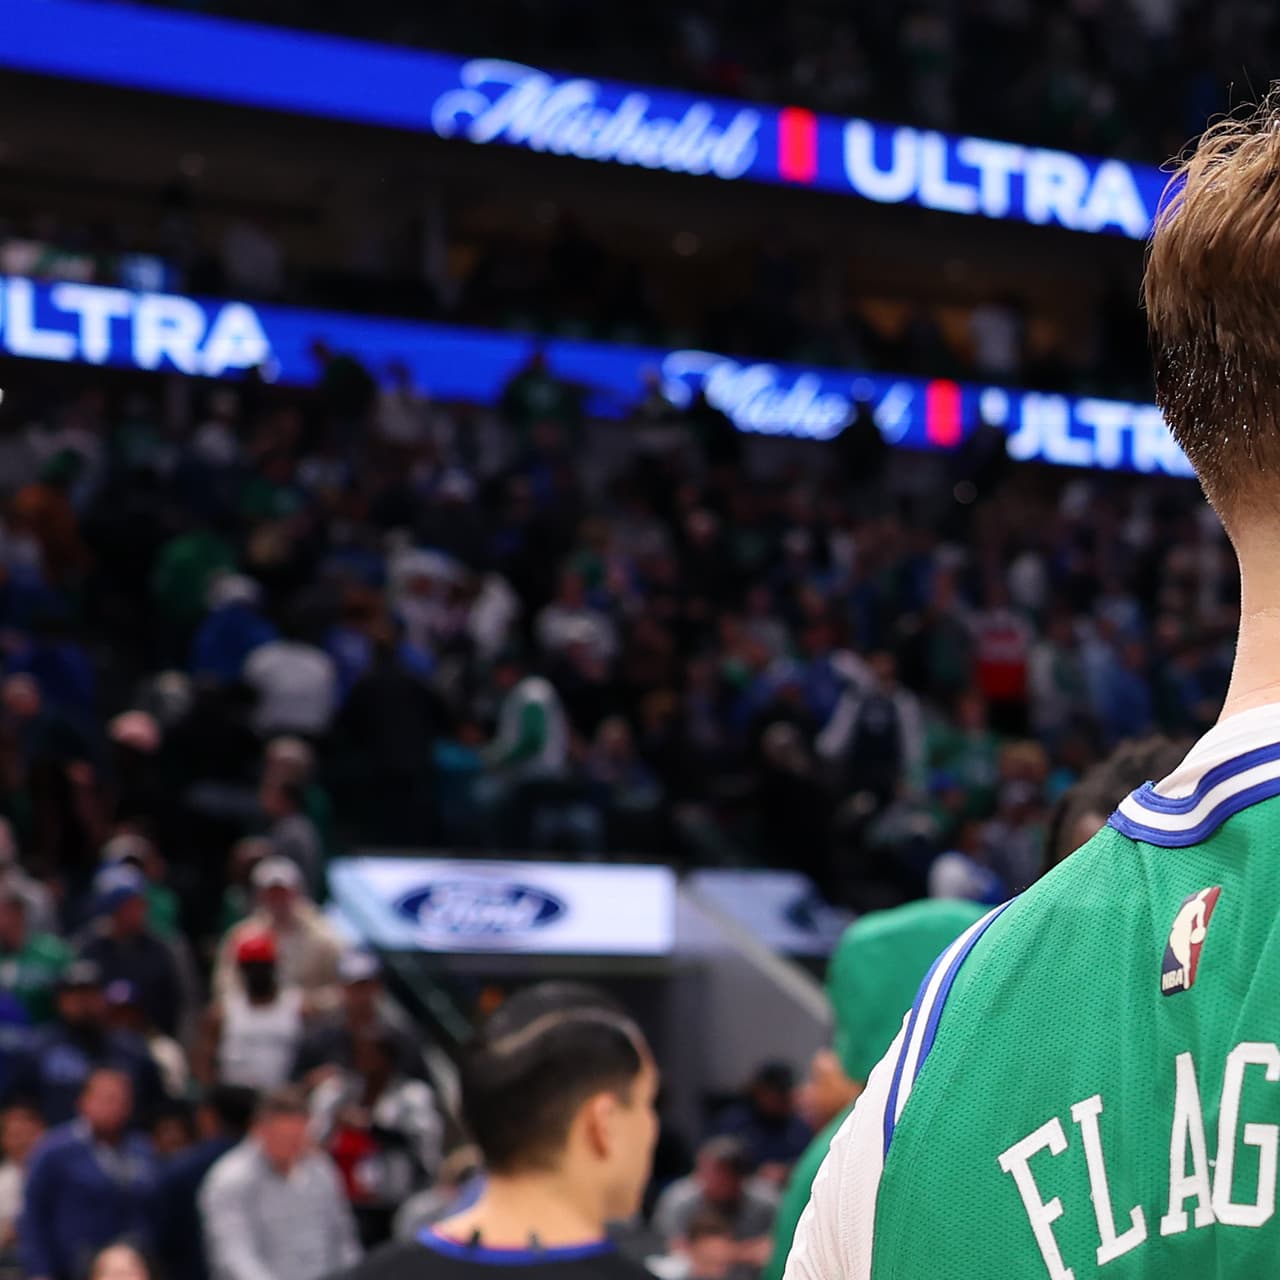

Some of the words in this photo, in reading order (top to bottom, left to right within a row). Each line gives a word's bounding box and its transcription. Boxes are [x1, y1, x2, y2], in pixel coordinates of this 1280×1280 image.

[843, 118, 1150, 240] ULTRA
[0, 277, 272, 378] LTRA
[980, 387, 1200, 478] ULTR
[1162, 968, 1184, 991] NBA
